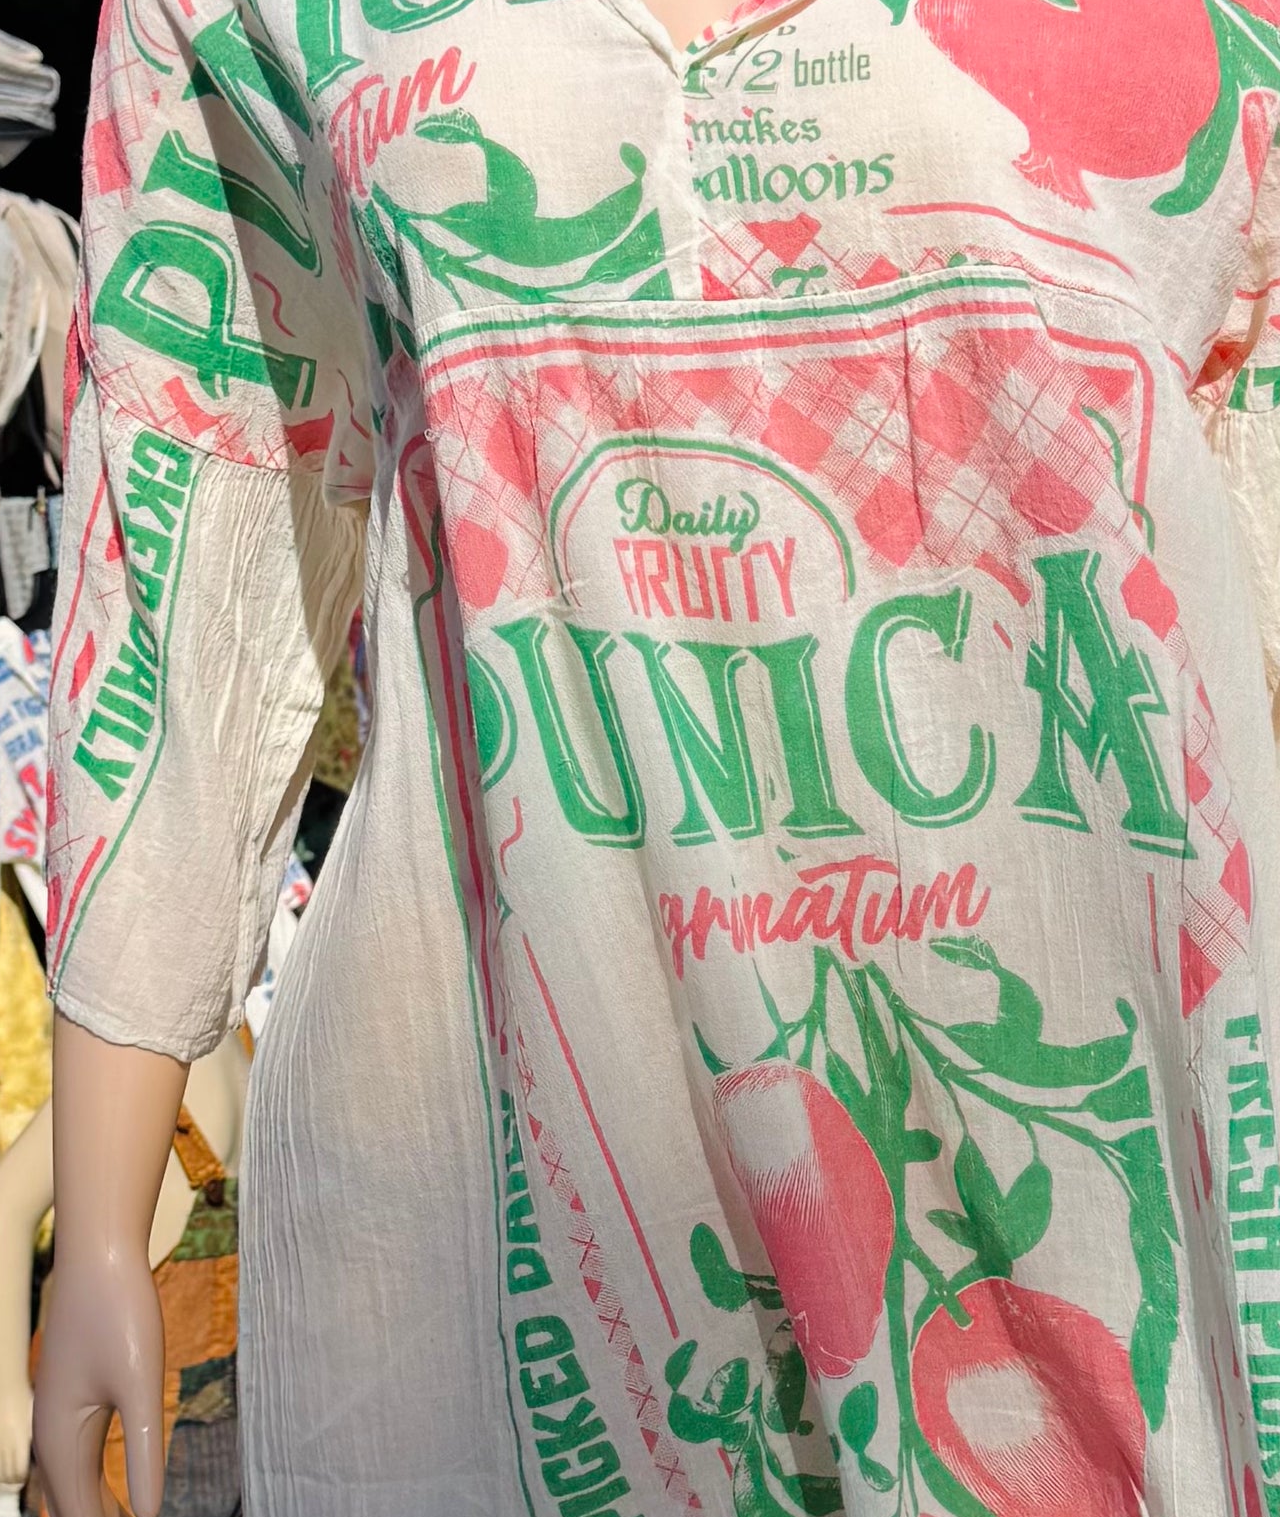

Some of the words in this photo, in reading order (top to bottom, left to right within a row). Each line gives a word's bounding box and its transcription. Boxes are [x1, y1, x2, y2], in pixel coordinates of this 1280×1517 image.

[794, 42, 871, 88] bottle
[690, 107, 822, 145] makes
[614, 476, 761, 554] Daily
